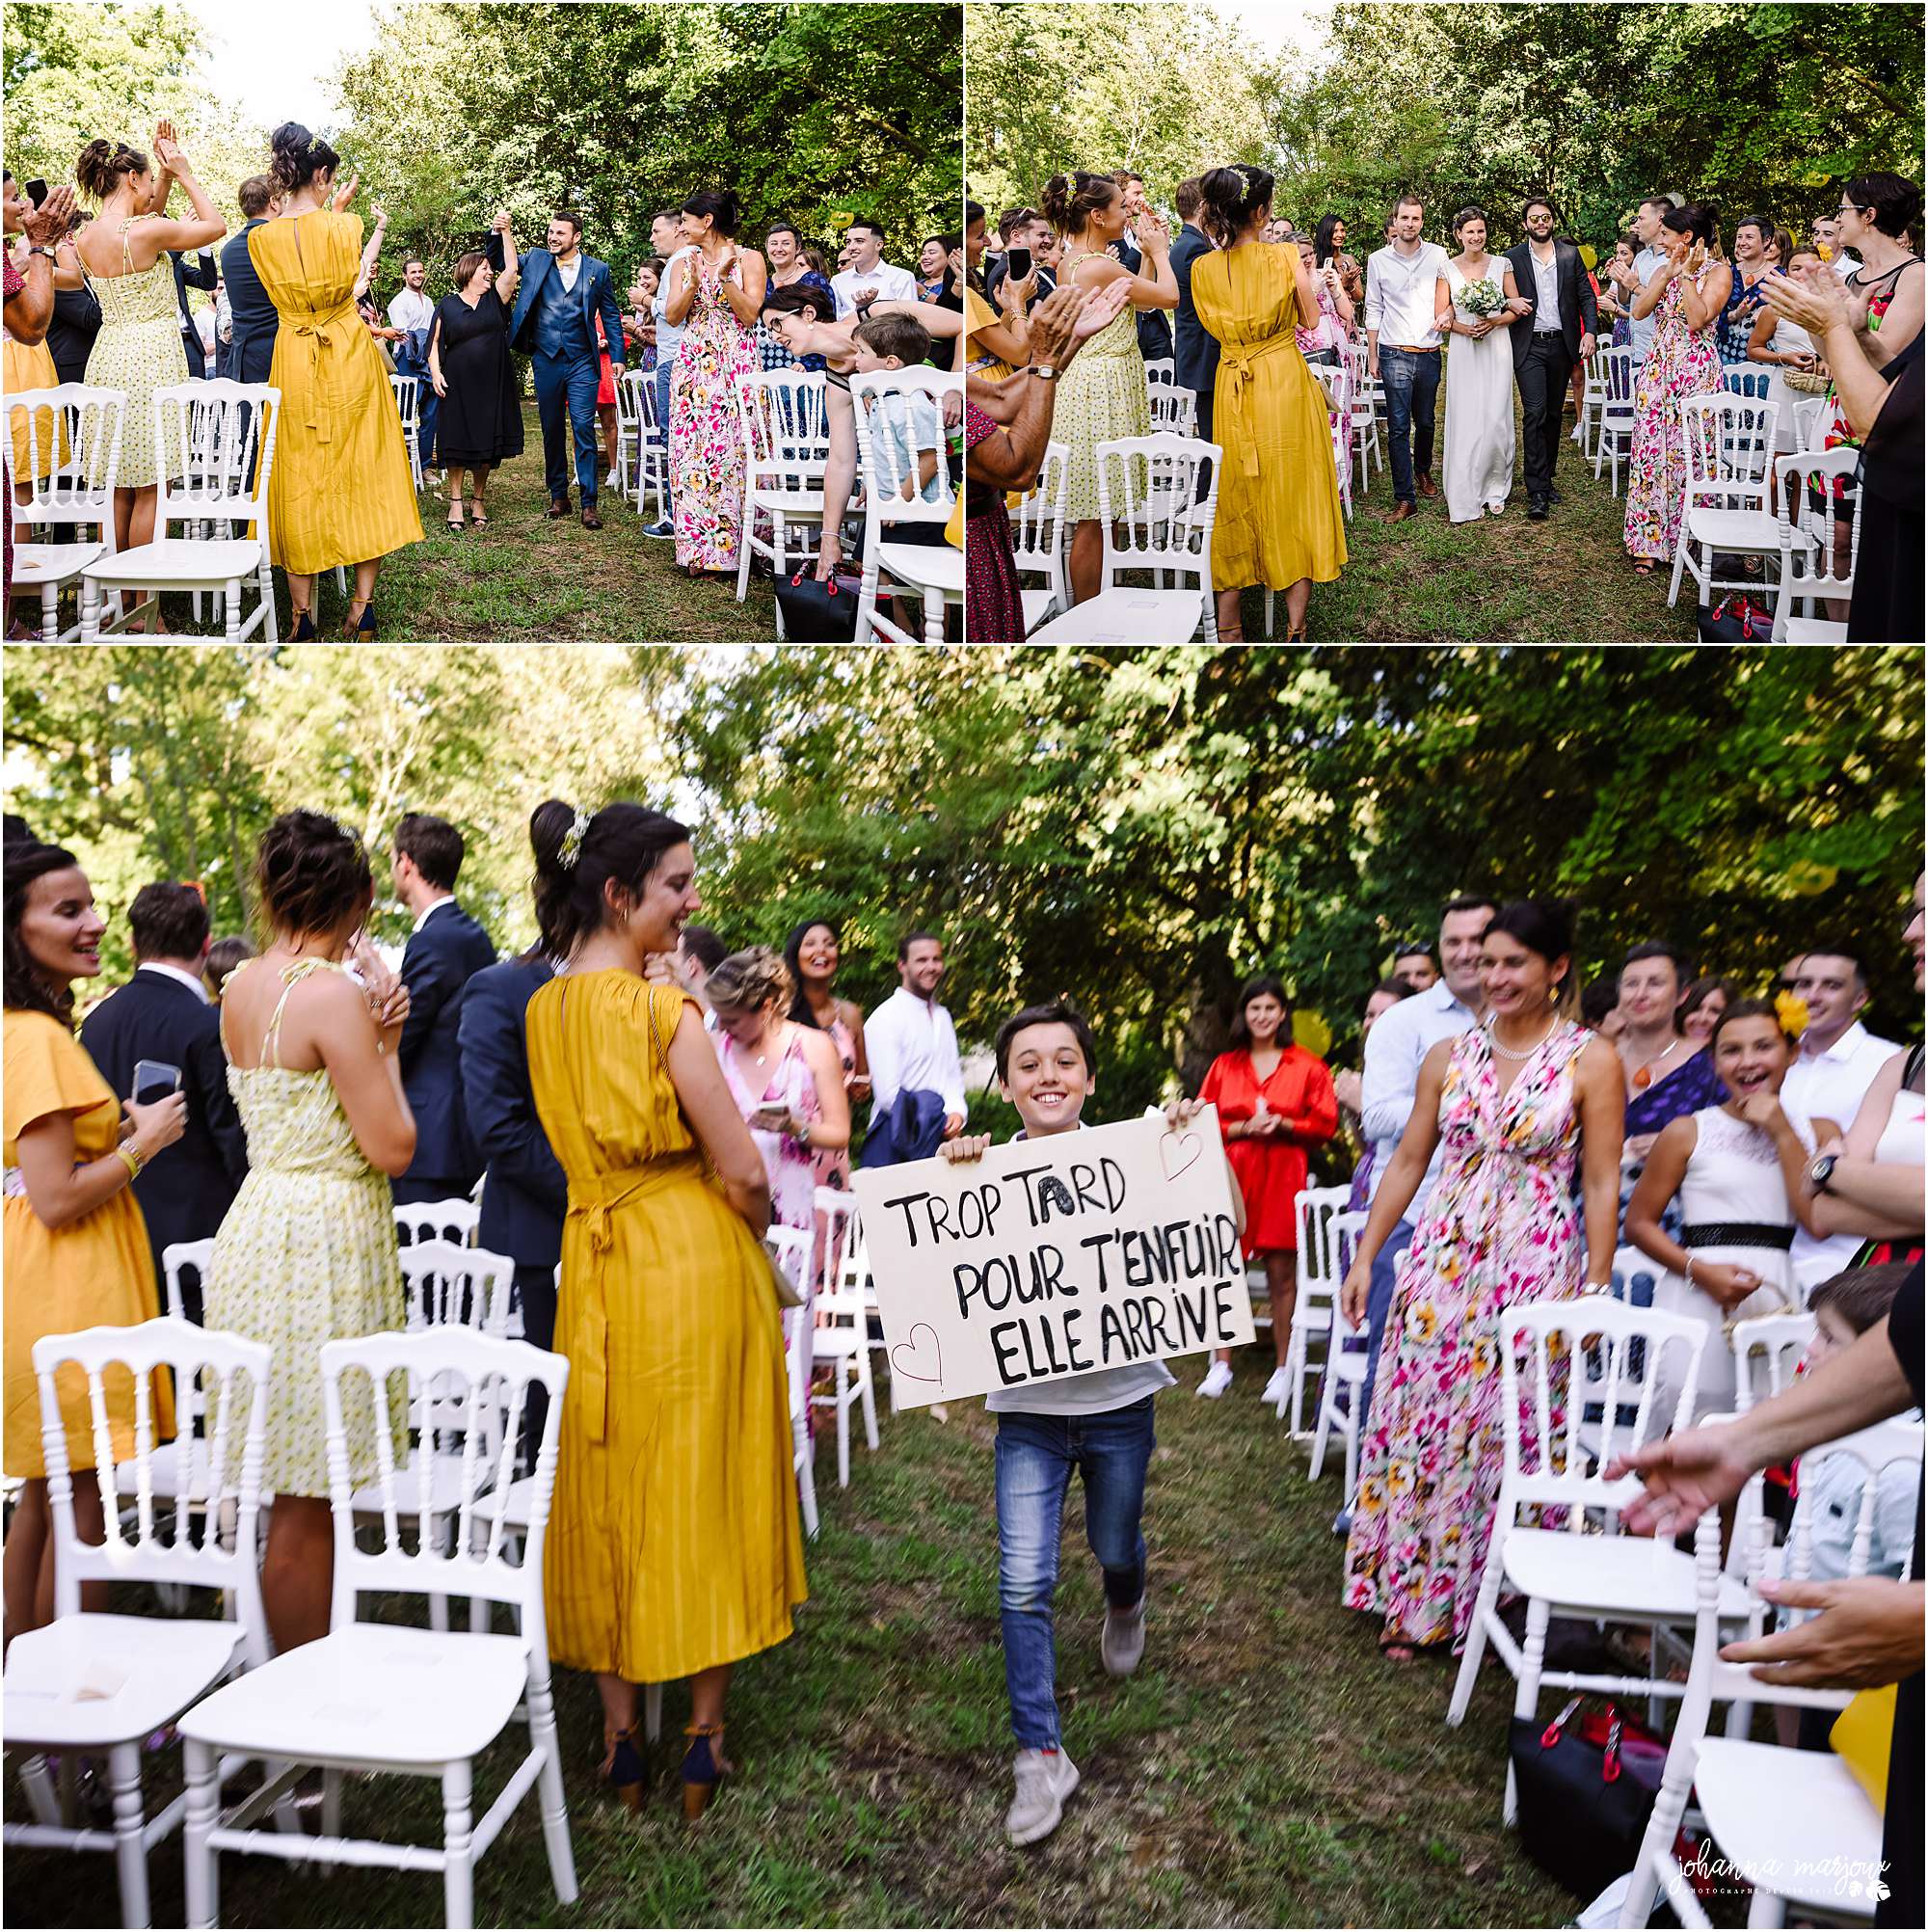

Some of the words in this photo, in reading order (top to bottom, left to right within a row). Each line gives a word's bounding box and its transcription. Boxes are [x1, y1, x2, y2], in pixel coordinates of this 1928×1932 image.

[884, 1184, 1002, 1248] TROP
[1002, 1157, 1126, 1227] TARD
[952, 1244, 1080, 1320] POUR
[990, 1308, 1095, 1385] ELLE
